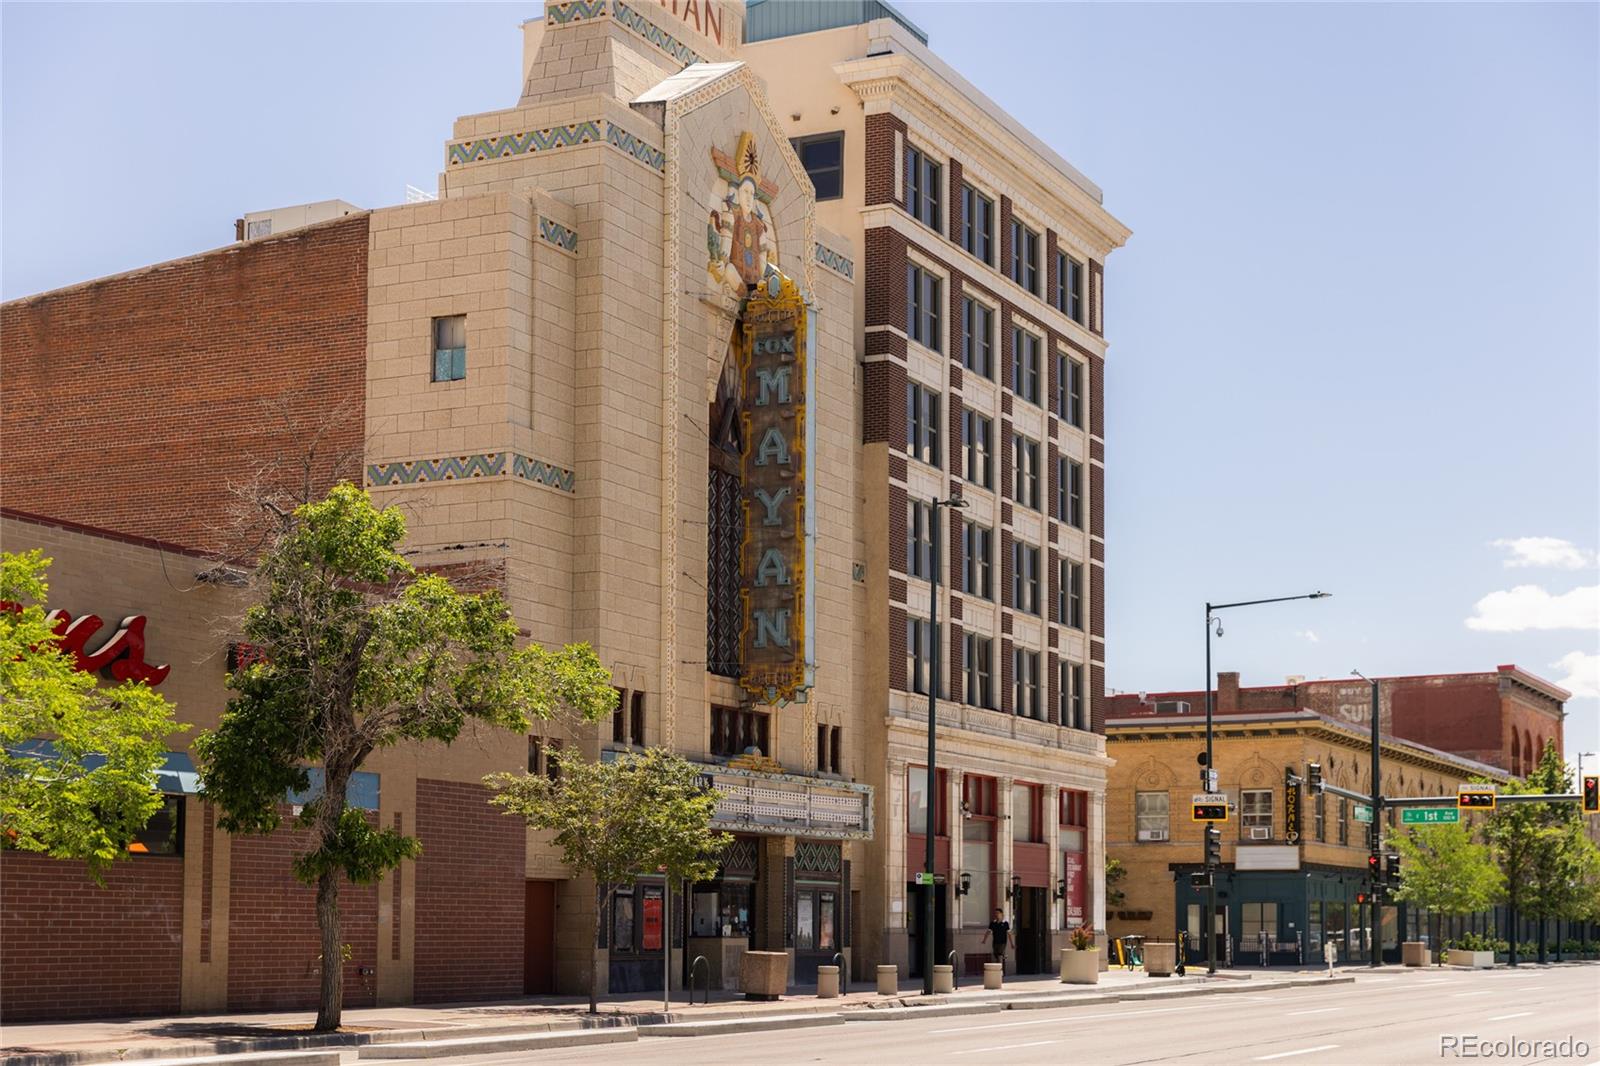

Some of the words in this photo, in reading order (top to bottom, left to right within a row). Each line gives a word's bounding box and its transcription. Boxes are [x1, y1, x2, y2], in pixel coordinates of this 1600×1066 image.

[753, 335, 795, 355] FOX
[754, 367, 792, 649] MAYAN
[1424, 811, 1438, 821] 1st
